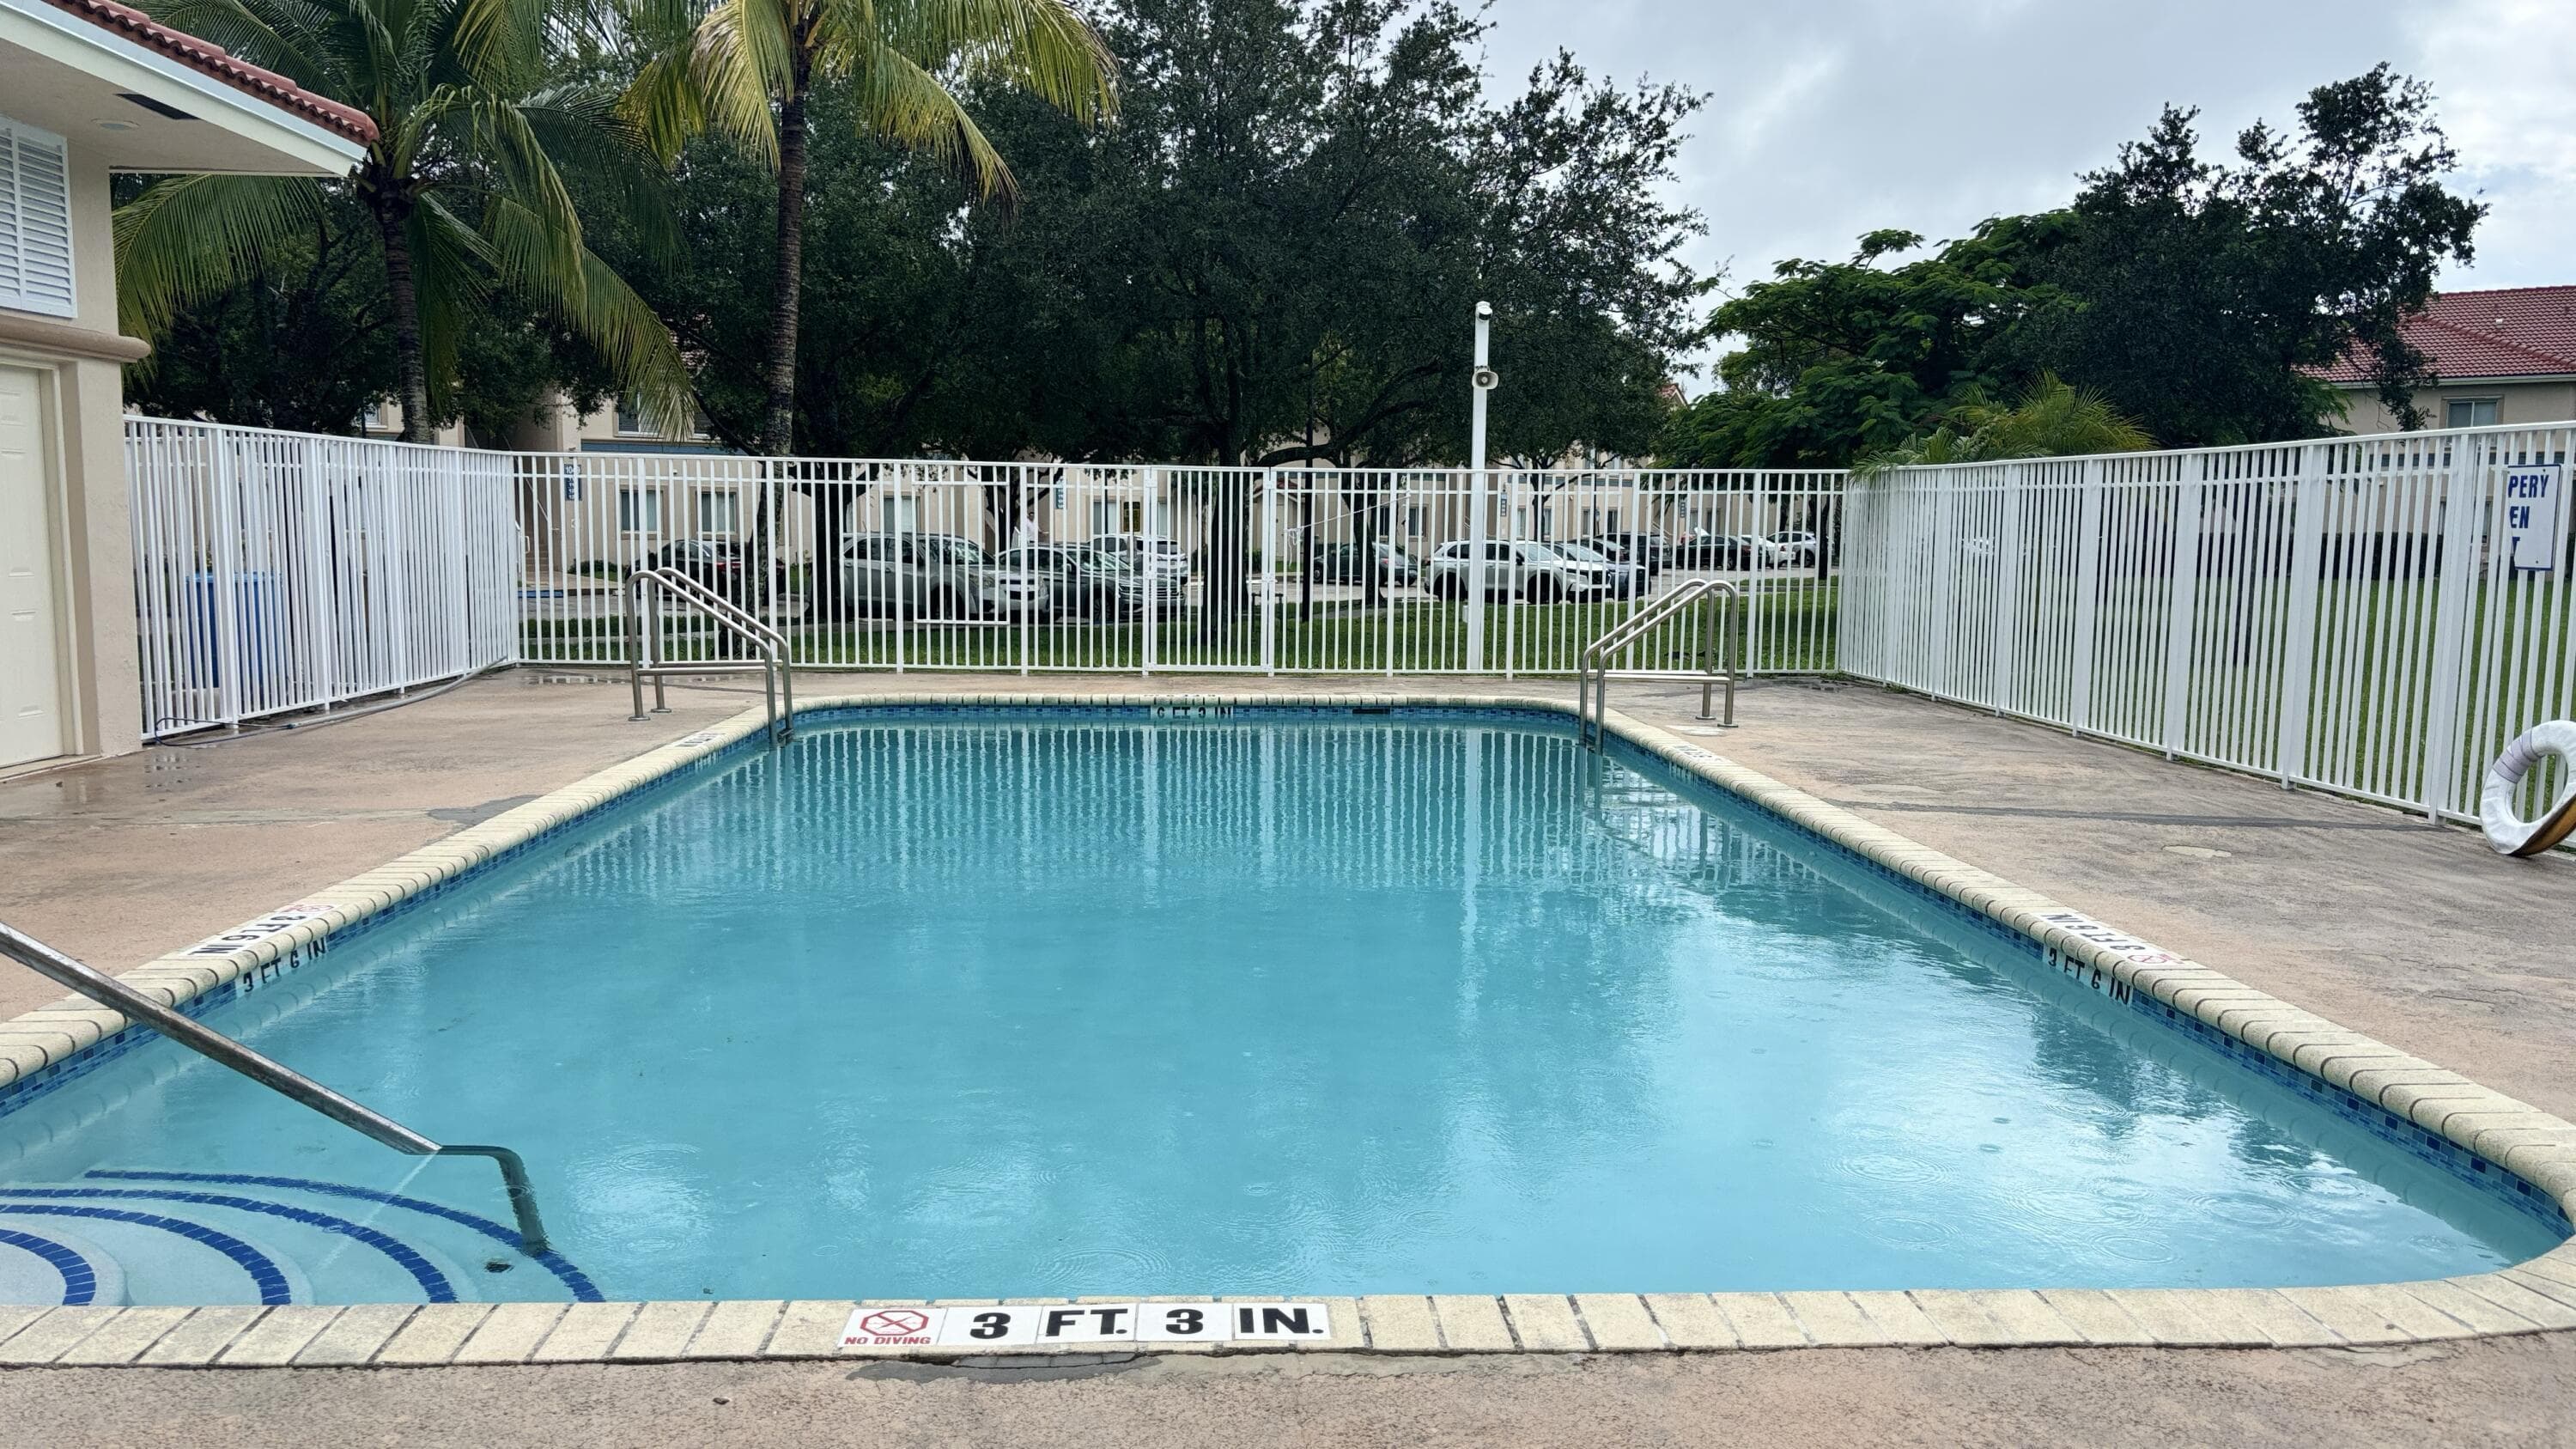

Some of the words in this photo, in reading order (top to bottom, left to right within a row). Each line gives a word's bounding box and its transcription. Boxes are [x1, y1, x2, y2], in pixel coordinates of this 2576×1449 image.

[2507, 475, 2549, 498] PERY
[2509, 506, 2530, 528] EN
[243, 971, 253, 992] 3
[260, 957, 281, 984] FT
[290, 950, 300, 969] 6
[307, 936, 326, 960] IN
[2048, 947, 2057, 967] 3
[2063, 955, 2086, 981] FT
[2091, 968, 2102, 989] 6
[2109, 977, 2130, 1005] IN
[969, 1312, 1011, 1339] 3
[1045, 1308, 1127, 1336] FT.
[1165, 1308, 1204, 1335] 3
[1239, 1307, 1324, 1335] IN.
[844, 1336, 869, 1345] NO
[873, 1336, 931, 1345] DIVING
